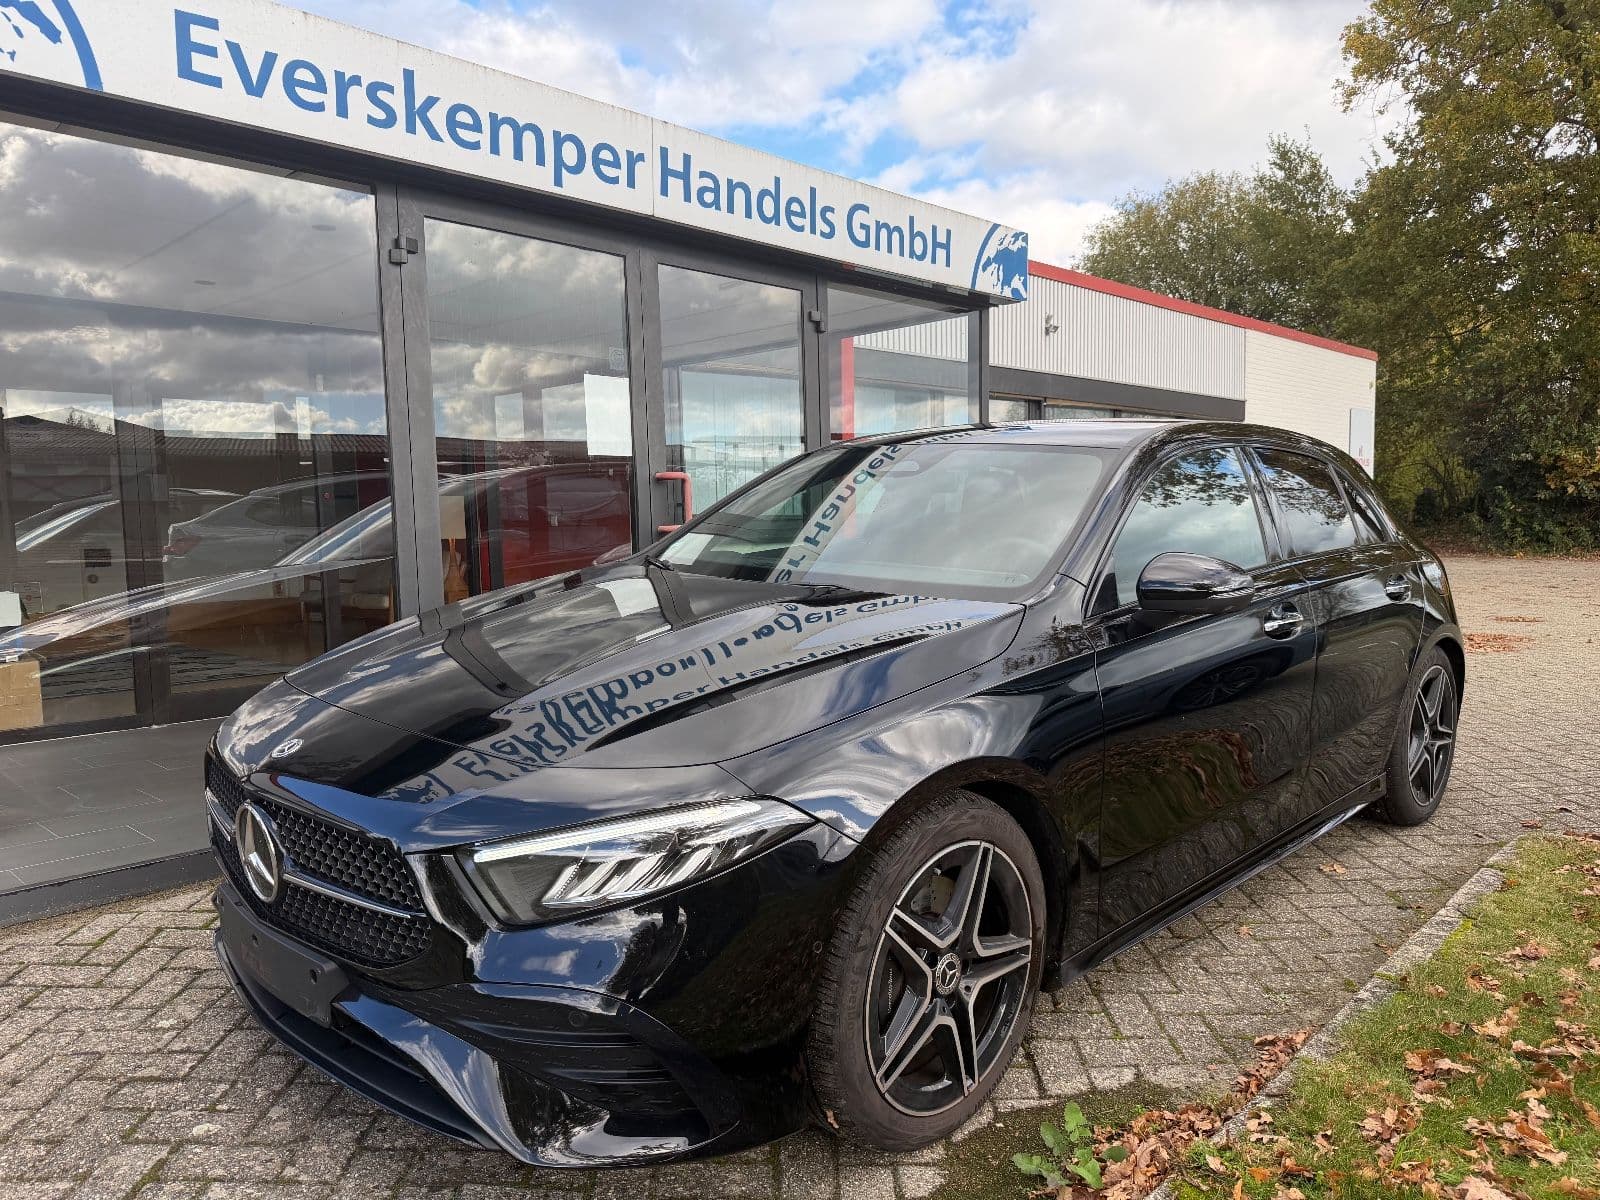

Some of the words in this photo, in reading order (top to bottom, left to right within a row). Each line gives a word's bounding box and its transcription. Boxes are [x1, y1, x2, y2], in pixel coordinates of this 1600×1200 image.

[174, 9, 646, 189] Everskemper
[659, 146, 836, 240] Handels
[846, 203, 952, 267] GmbH
